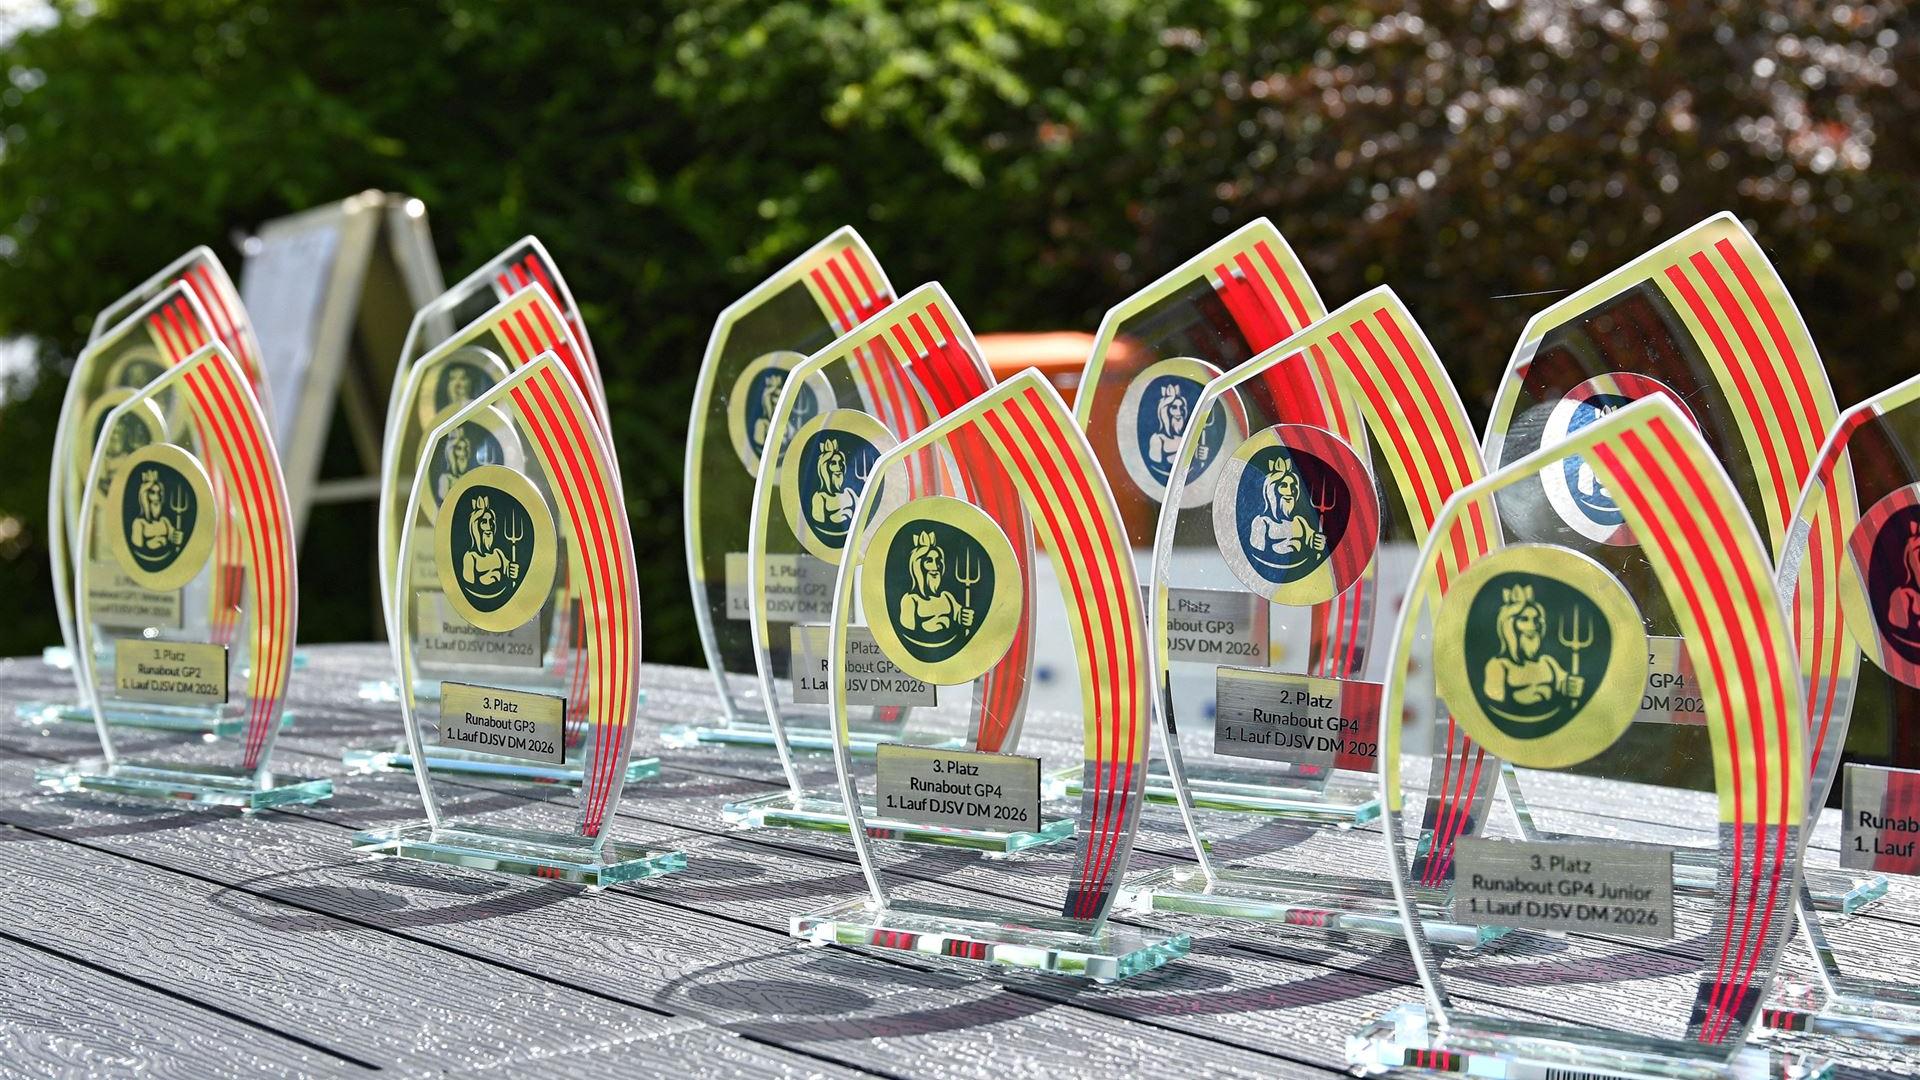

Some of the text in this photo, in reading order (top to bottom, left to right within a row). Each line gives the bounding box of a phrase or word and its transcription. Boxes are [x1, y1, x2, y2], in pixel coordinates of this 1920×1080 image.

[765, 582, 801, 594] nabout
[1179, 598, 1211, 614] Platz
[1167, 618, 1234, 635] about GP3
[163, 650, 185, 661] Platz
[435, 639, 456, 651] Lauf
[458, 639, 485, 652] DJSV
[487, 641, 504, 653] DM
[507, 642, 533, 656] 2026
[851, 641, 880, 654] Platz
[1198, 639, 1222, 653] DM
[1225, 641, 1260, 656] 2026
[138, 663, 202, 679] Runabout GP2
[821, 658, 874, 673] Rbout
[122, 678, 219, 696] 1. Lauf DJSV DM 2026
[801, 677, 829, 690] 1. Lau
[845, 679, 925, 693] JSV DM 2026
[1649, 673, 1685, 689] GP4
[483, 697, 518, 713] 3. Platz
[1280, 690, 1333, 709] 2. Platz
[1641, 695, 1705, 713] DM 202
[465, 712, 536, 733] Runabout GP3
[1253, 708, 1359, 733] Runabout GP4
[447, 727, 555, 754] 1. Lauf DJSV DM 2026
[1225, 726, 1377, 758] 1. Lauf DJSV DM 202
[933, 759, 979, 776] 3. Platz
[910, 777, 1002, 799] Runabout GP4
[886, 794, 1027, 822] 1. Lauf DJSV DM 2026
[1860, 811, 1920, 833] Runab
[1854, 836, 1916, 857] 1. Lauf
[1530, 854, 1592, 875] 3. Platz
[1472, 874, 1653, 902] Runabout GP4 Junior
[1470, 897, 1659, 926] 1. Lauf DJSV DM 2026
